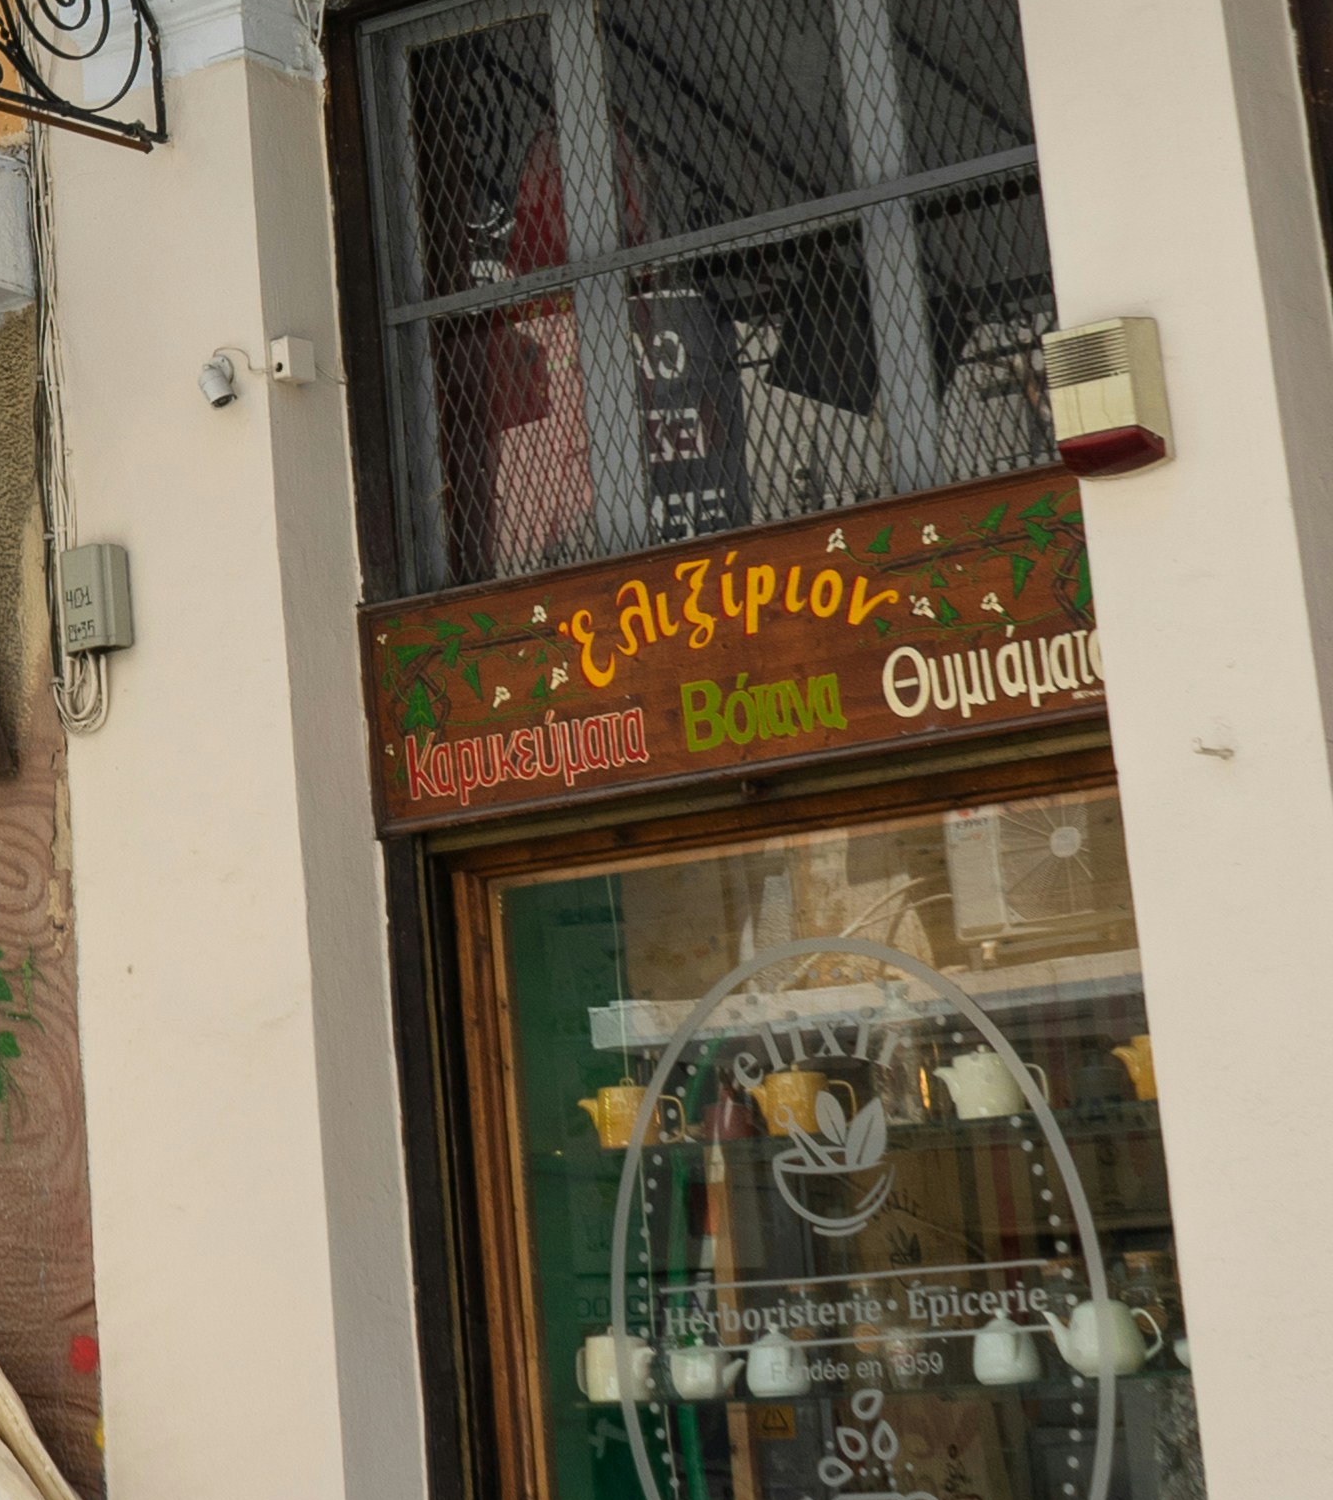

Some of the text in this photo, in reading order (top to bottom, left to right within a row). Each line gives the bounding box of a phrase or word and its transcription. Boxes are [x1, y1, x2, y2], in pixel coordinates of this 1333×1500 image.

[406, 672, 847, 805] Καρυκεύματα Βότανα
[735, 1021, 902, 1087] elixir
[665, 1280, 1047, 1338] Herboristerie Épicerie
[856, 1361, 883, 1378] en
